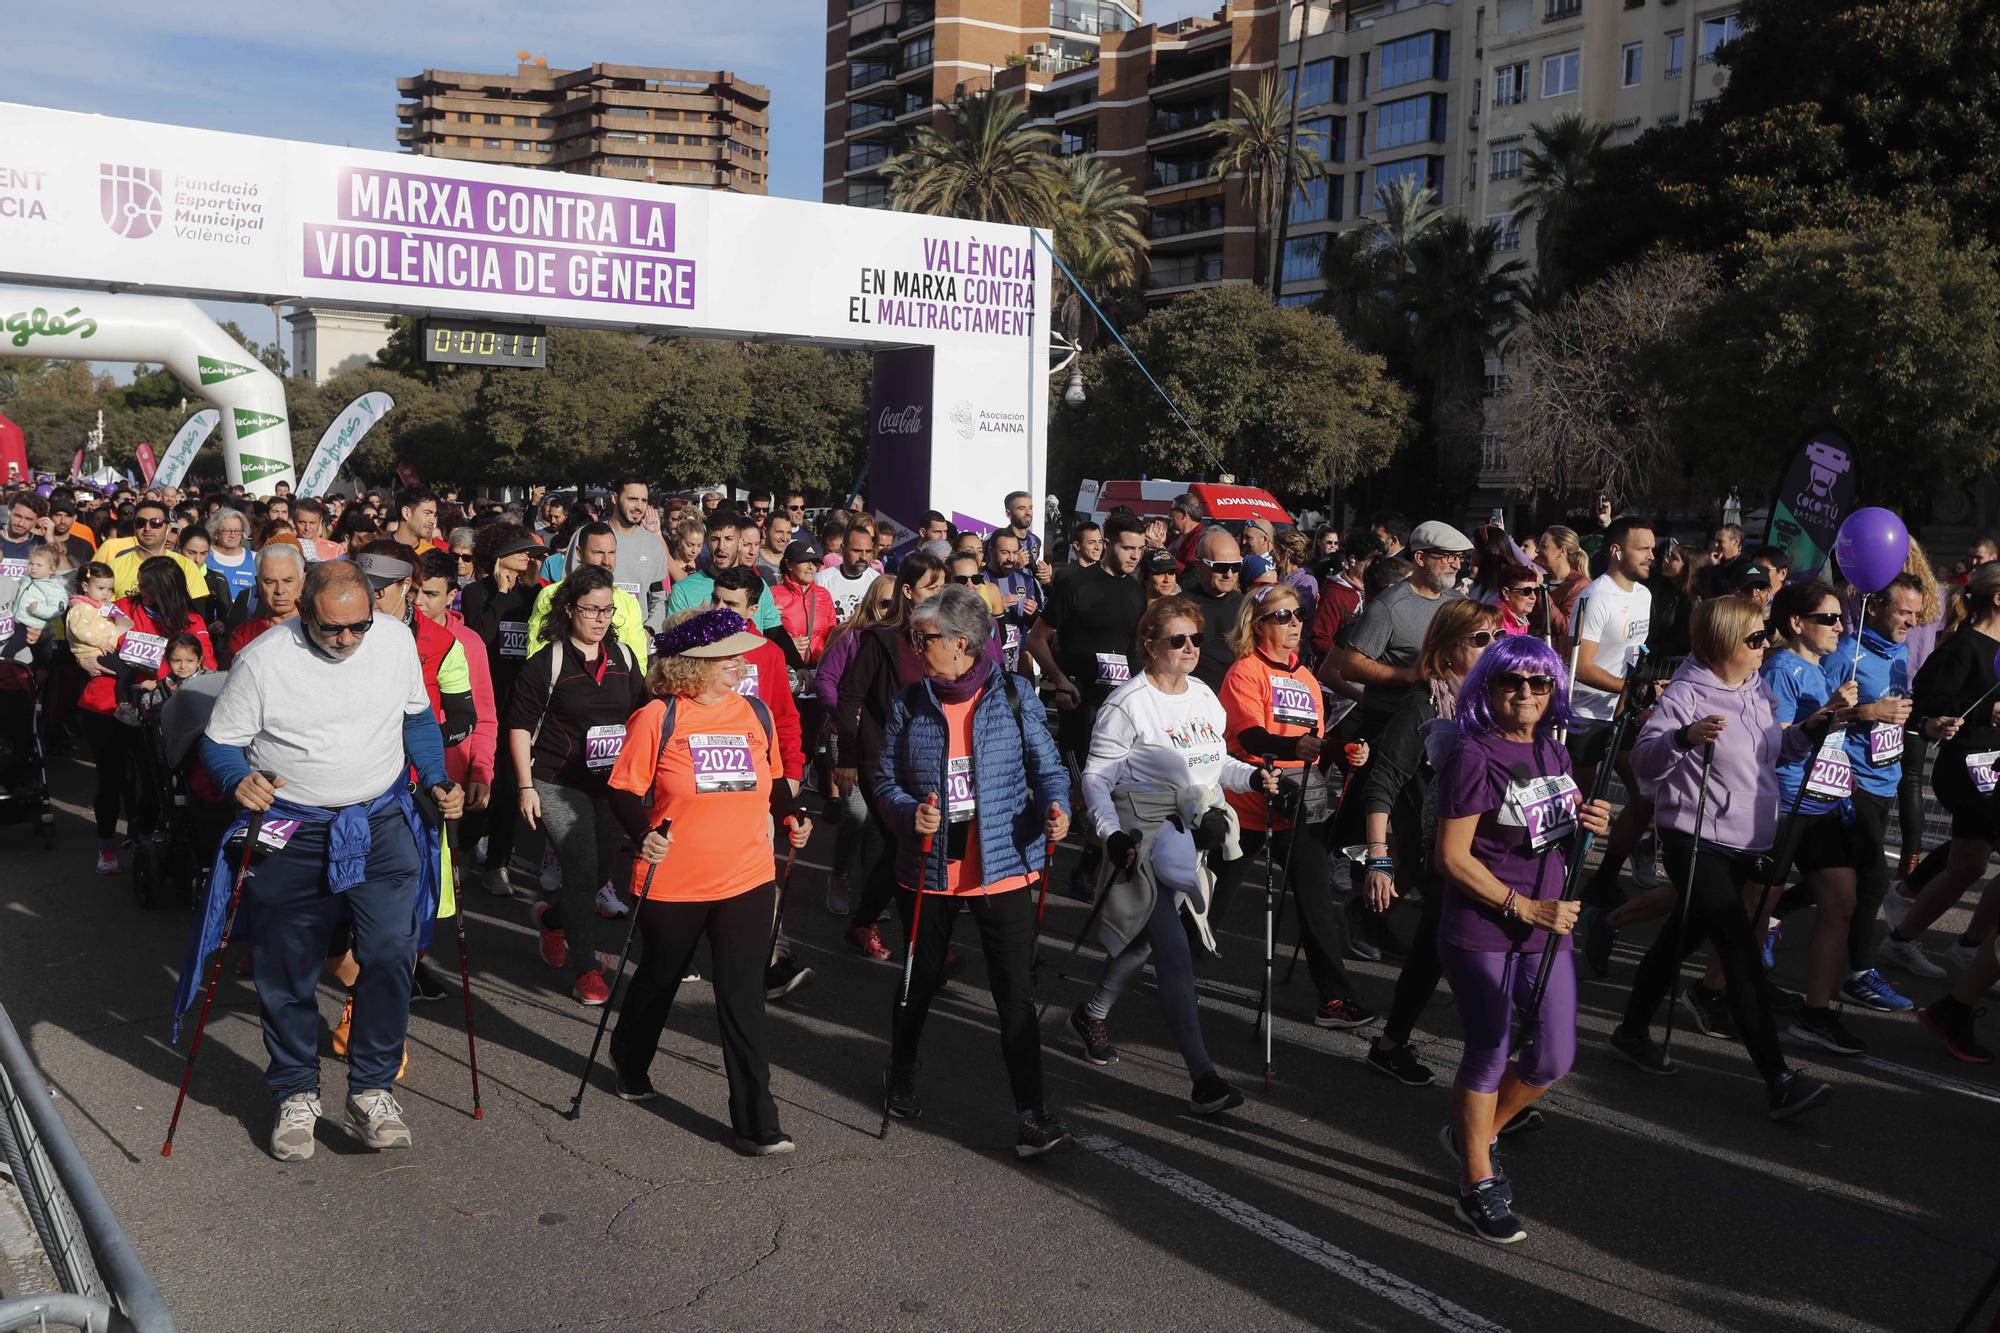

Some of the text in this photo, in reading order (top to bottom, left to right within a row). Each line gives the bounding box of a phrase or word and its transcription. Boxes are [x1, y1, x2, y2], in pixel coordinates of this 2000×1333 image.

[175, 175, 259, 197] Fundació
[175, 192, 262, 213] Esportiva
[351, 173, 666, 248] MARXA CONTRA LA
[174, 208, 264, 230] Municipal
[174, 225, 251, 245] València
[315, 229, 692, 306] VIOLÈNCIA DE GÈNERE
[923, 236, 1036, 281] VALÈNCIA
[861, 267, 1035, 309] EN MARXA CONTRA
[849, 296, 1035, 337] EL MALTRACTAMENT
[979, 410, 1025, 421] Asociación
[979, 420, 1025, 434] ALANNA
[124, 640, 161, 661] 2022
[1101, 662, 1130, 681] 2022
[1276, 688, 1313, 712] 2022
[589, 737, 623, 758] 2022
[1875, 726, 1903, 752] 2022
[698, 748, 749, 772] 2022
[1812, 761, 1851, 789] 2022
[1531, 793, 1577, 834] 2022
